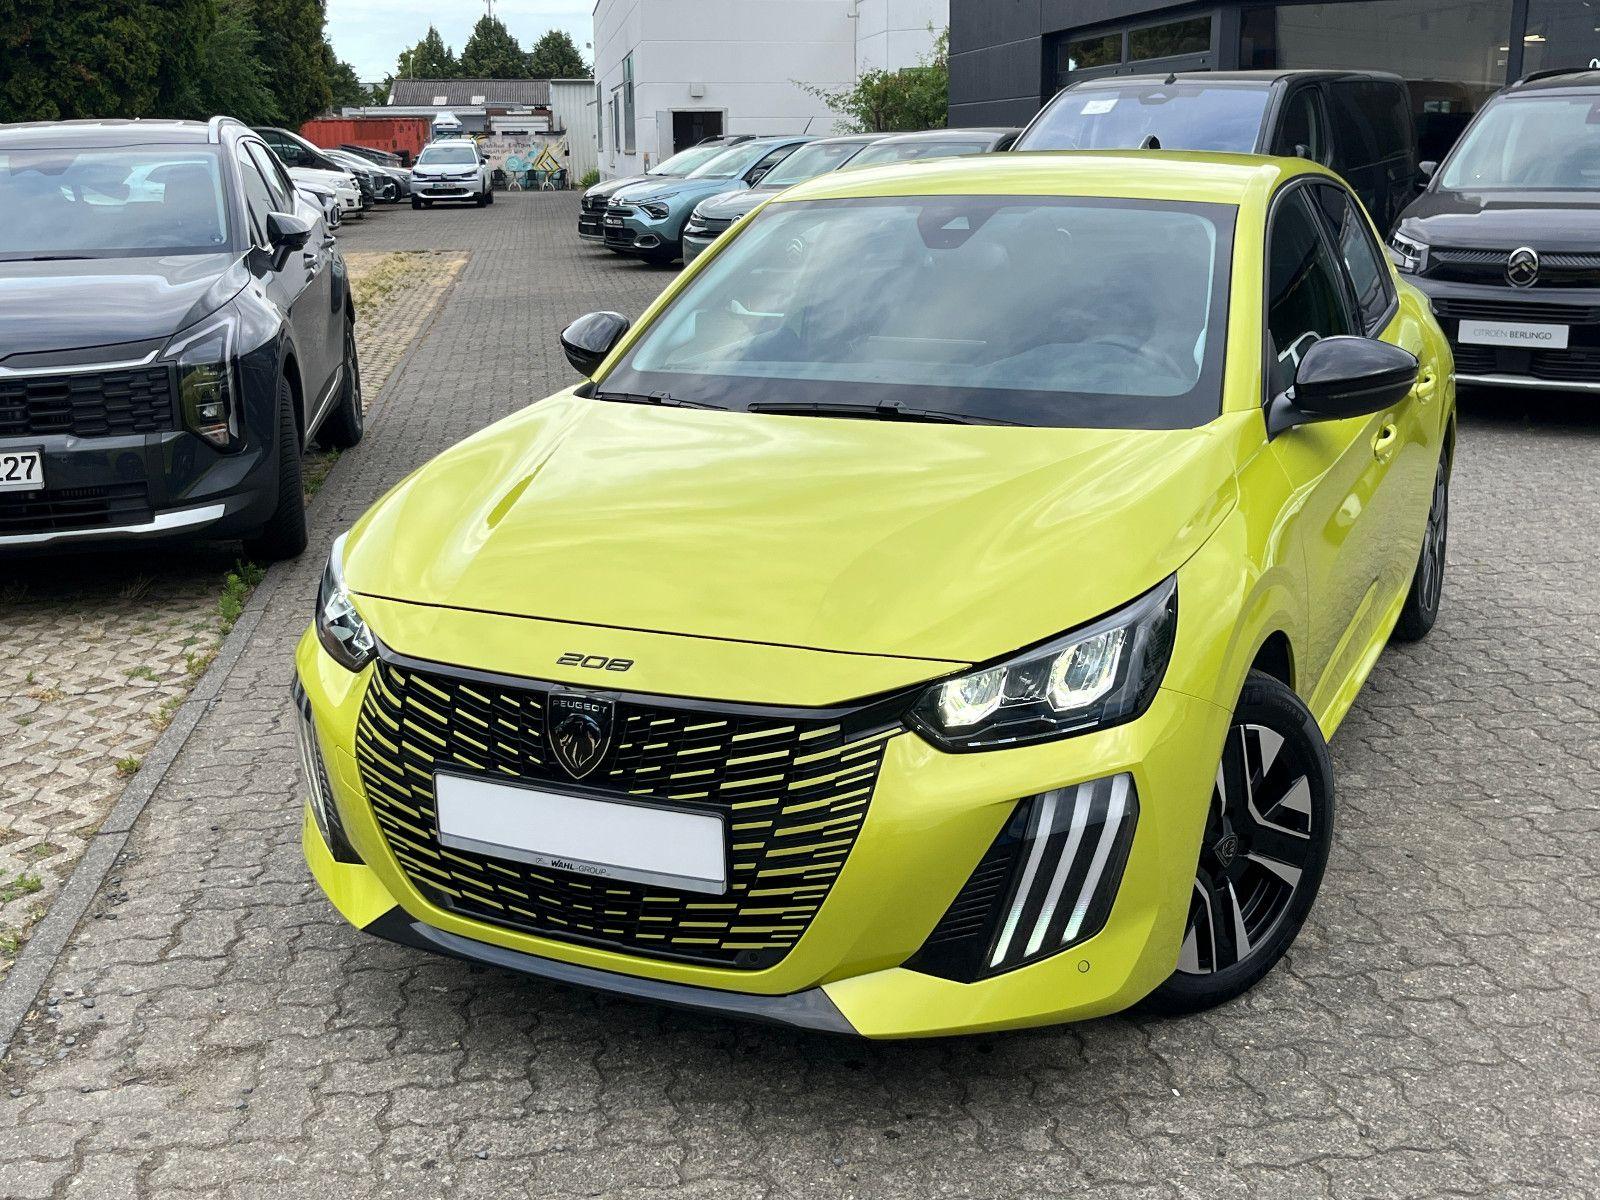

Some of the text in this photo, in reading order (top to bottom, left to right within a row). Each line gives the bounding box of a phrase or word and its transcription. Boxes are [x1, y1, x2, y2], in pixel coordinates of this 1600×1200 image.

[1509, 329, 1552, 340] BERLINGO
[0, 455, 37, 482] 27
[556, 652, 634, 671] 208
[552, 700, 607, 713] PEUGEOT
